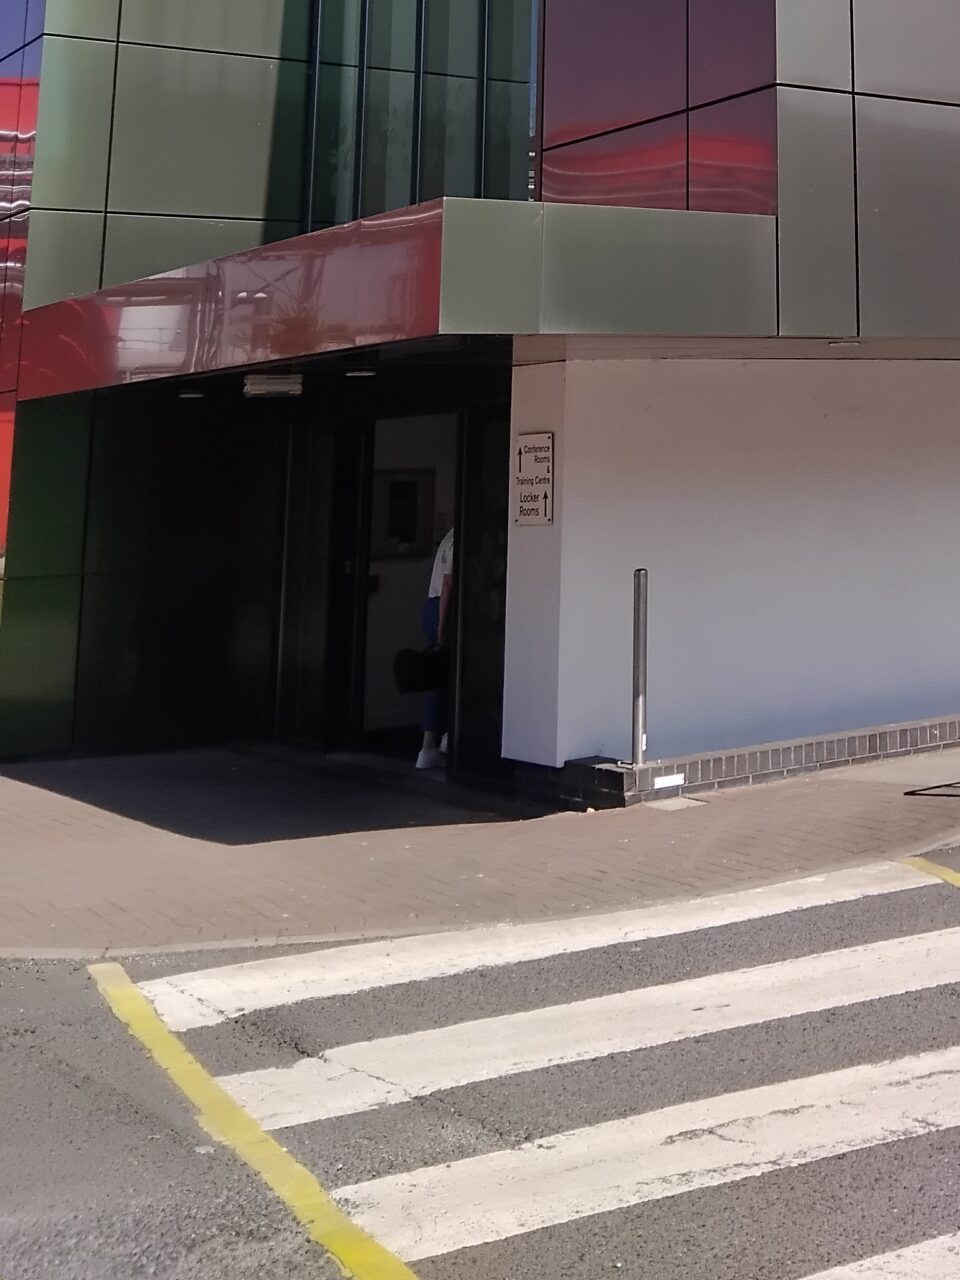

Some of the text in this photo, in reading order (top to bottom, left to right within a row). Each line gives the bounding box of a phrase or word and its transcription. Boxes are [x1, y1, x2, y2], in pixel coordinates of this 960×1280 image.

[524, 445, 550, 454] Conference
[534, 455, 550, 464] Rooms
[516, 476, 550, 486] Training Centre
[520, 492, 539, 504] Locker
[519, 506, 539, 517] Rooms
